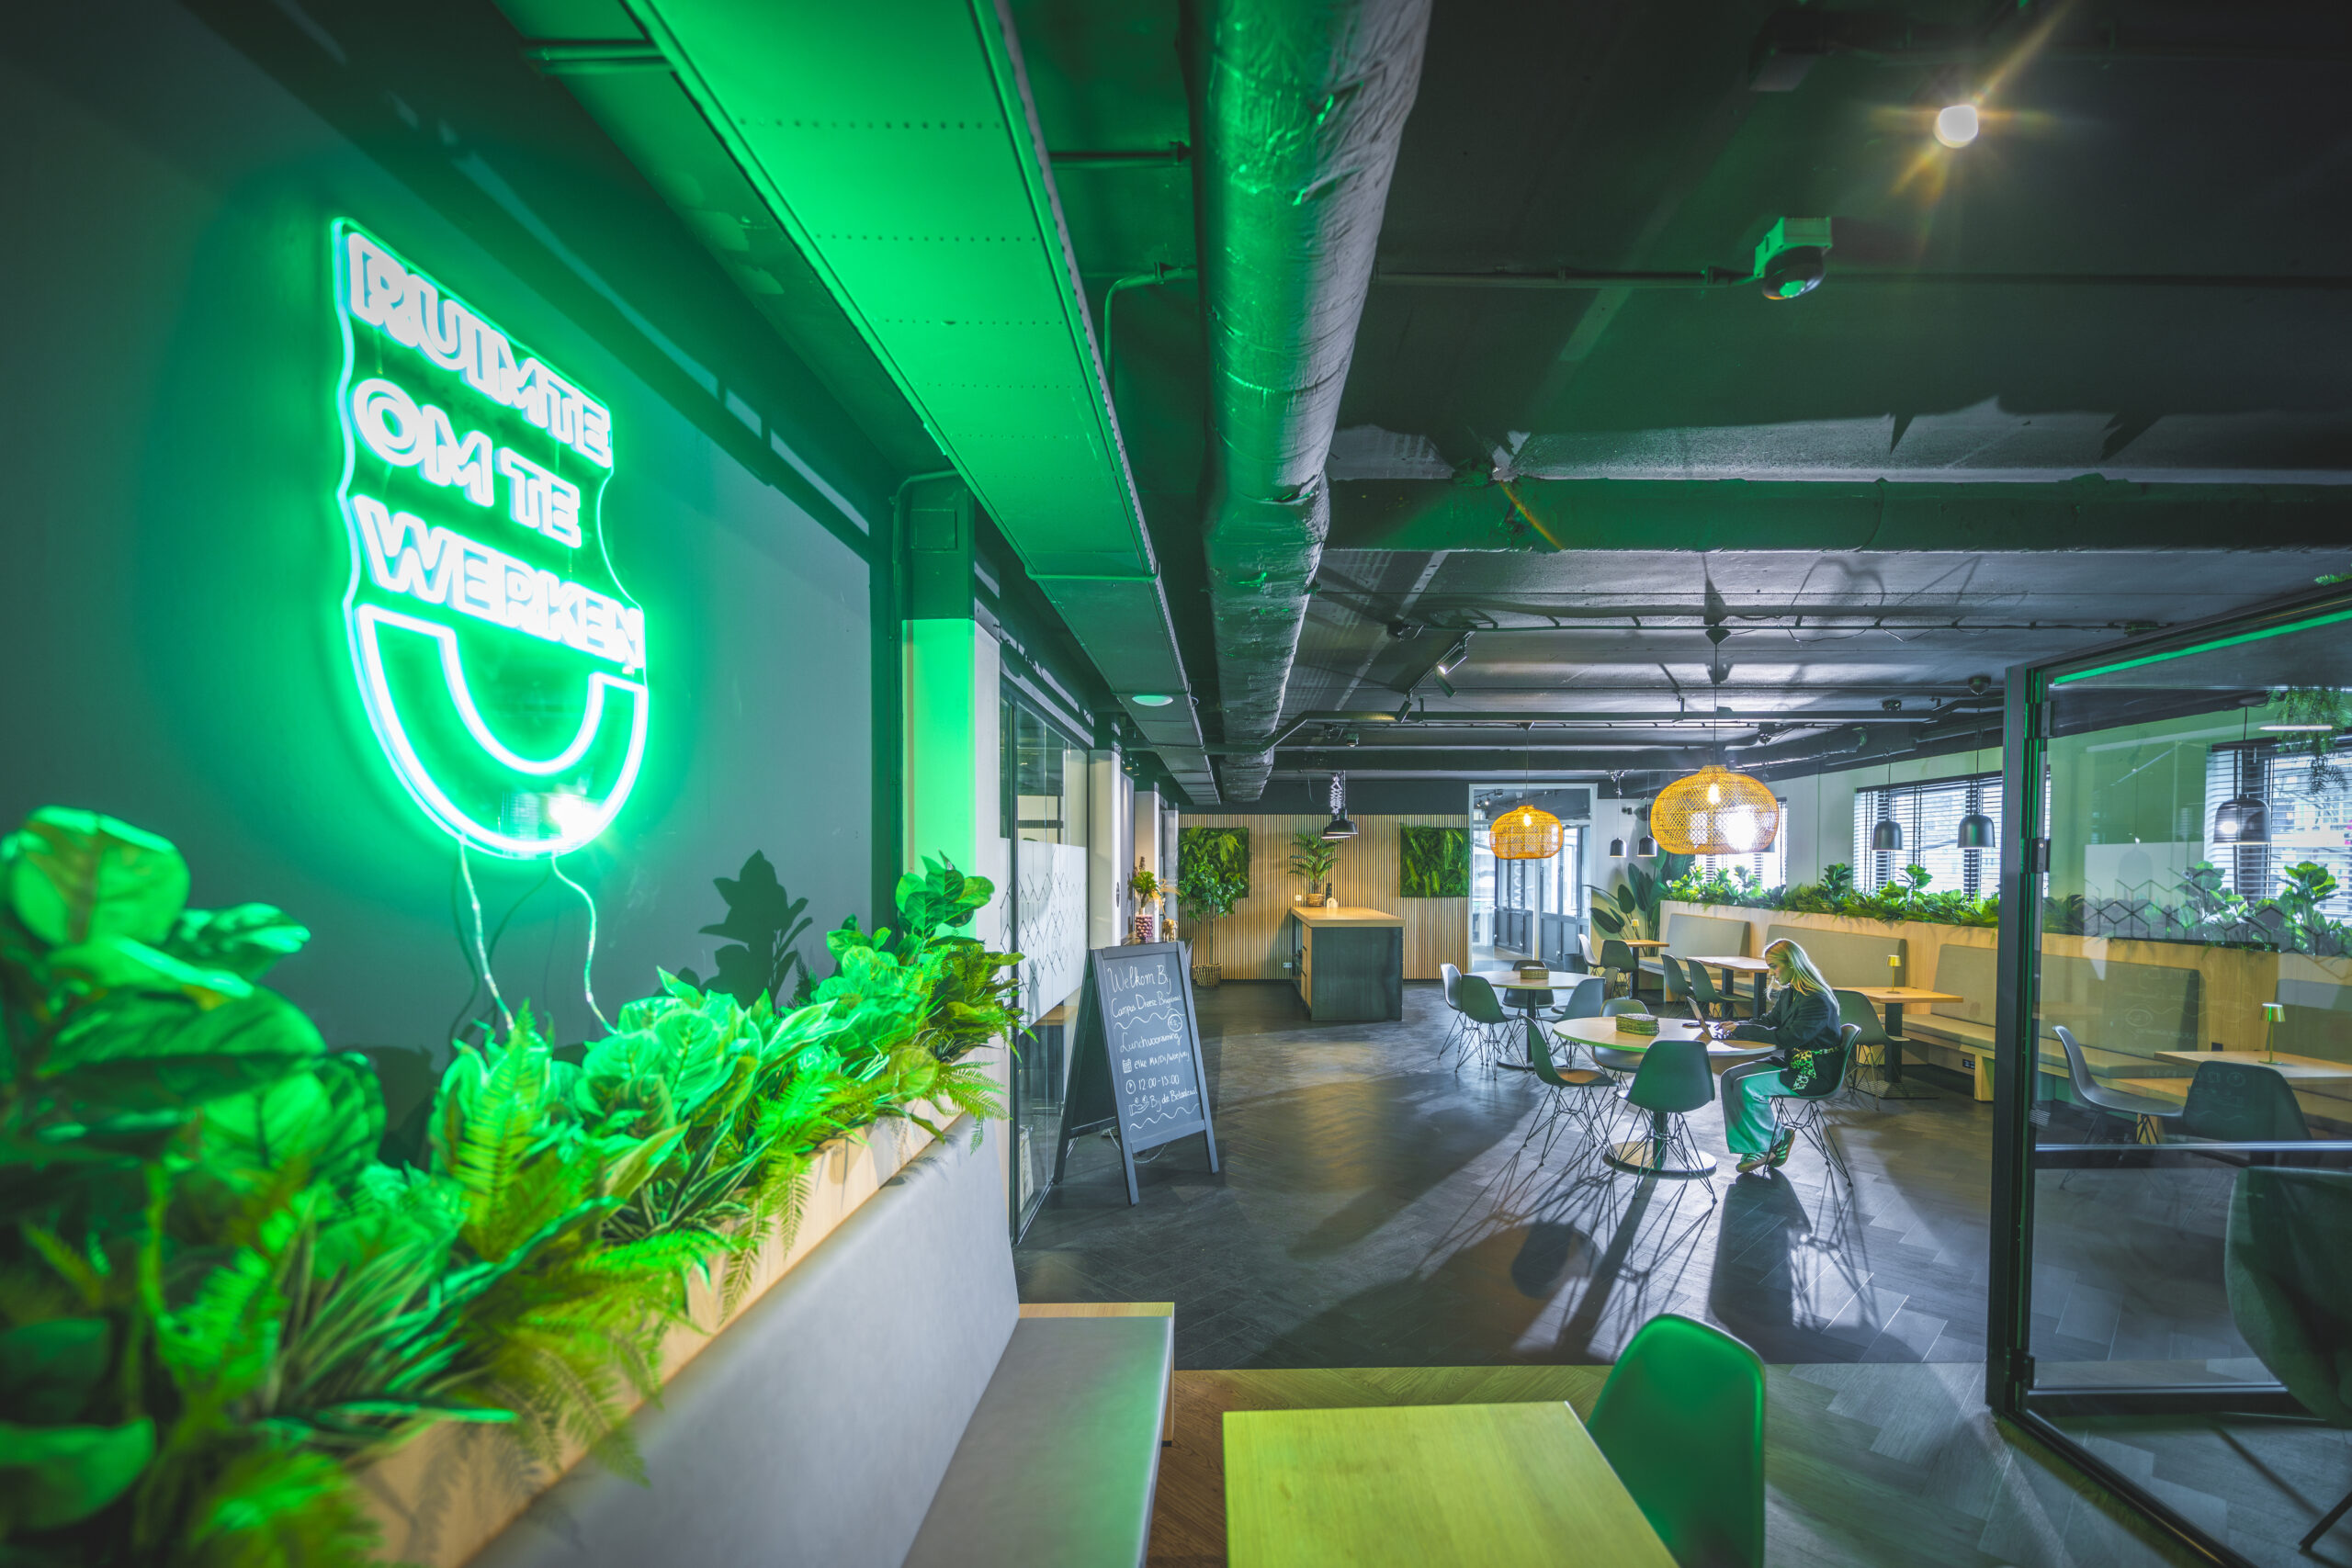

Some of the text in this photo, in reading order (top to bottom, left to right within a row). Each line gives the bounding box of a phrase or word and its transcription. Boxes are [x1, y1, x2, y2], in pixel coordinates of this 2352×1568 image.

[348, 232, 613, 468] RUIMTE
[352, 378, 582, 548] OM TE
[349, 495, 645, 669] WERKEN
[1107, 965, 1155, 992] Welkom
[1112, 998, 1136, 1017] Campus
[1161, 1093, 1170, 1104] de
